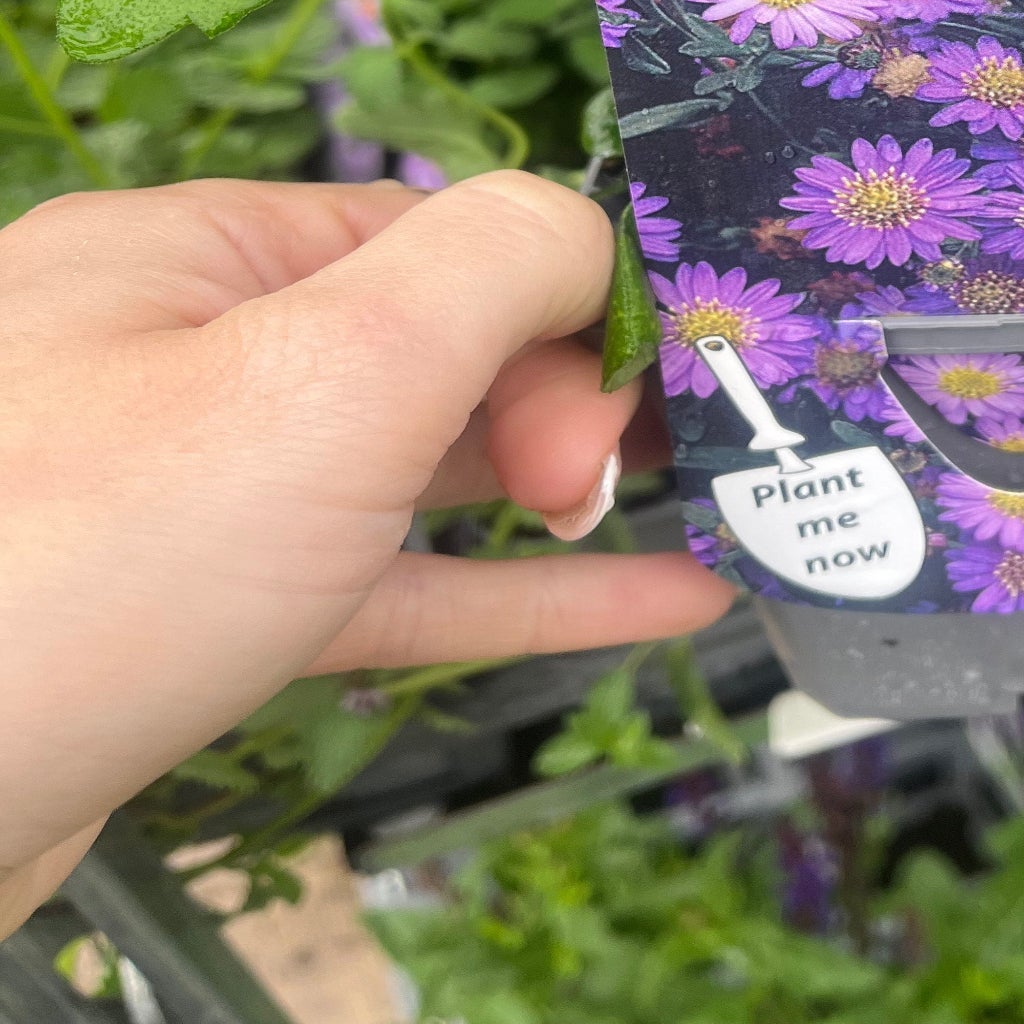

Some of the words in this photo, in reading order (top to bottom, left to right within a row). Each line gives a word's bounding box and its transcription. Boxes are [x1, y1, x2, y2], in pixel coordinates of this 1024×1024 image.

[752, 467, 864, 507] Plant
[797, 511, 860, 538] me
[805, 541, 890, 573] now
